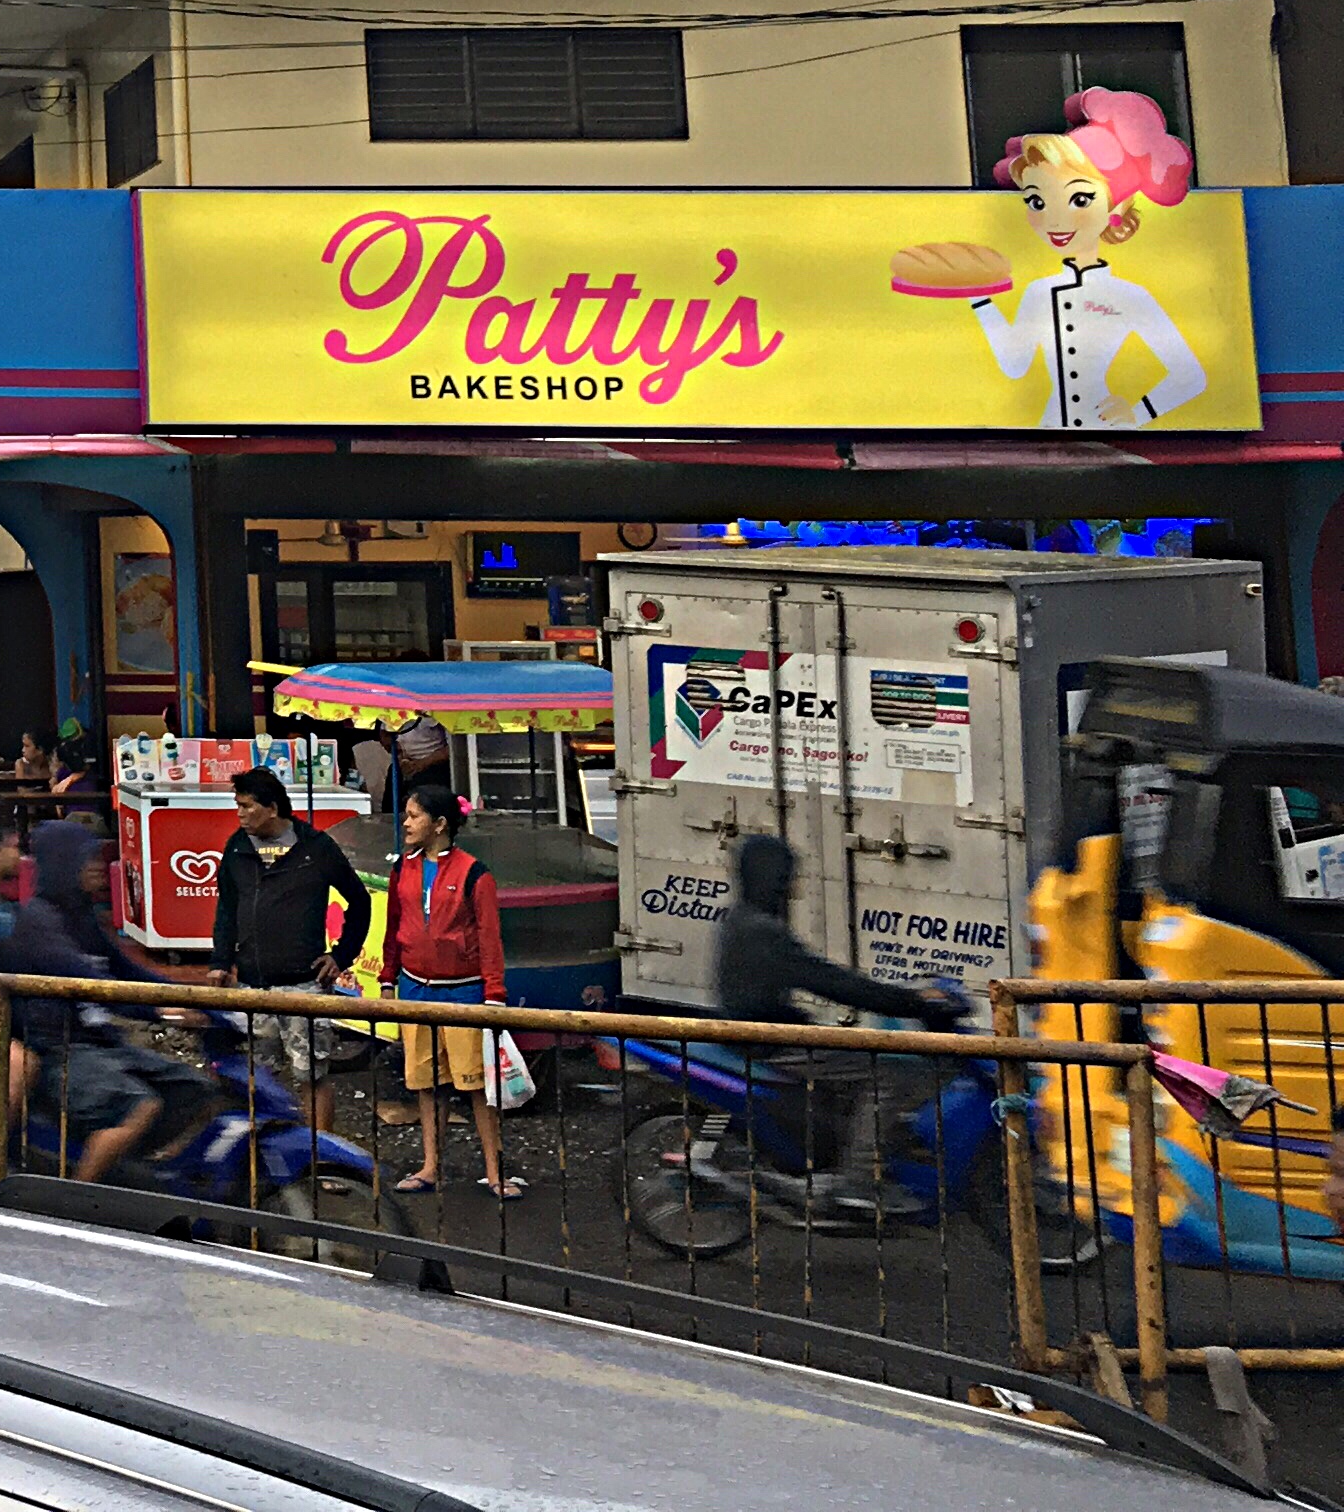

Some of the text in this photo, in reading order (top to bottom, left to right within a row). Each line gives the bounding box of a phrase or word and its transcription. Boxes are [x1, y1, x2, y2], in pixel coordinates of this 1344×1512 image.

[321, 209, 786, 405] Patty's
[409, 374, 624, 400] BAKESHOP
[723, 687, 838, 719] CaPEx
[729, 740, 769, 756] Cargo
[176, 887, 220, 897] SELECT
[664, 874, 730, 898] KEEP
[862, 909, 1007, 950] NOT FOR HIRE
[907, 945, 927, 957] MY
[930, 949, 994, 968] DRIVING?
[913, 961, 964, 976] HOTLINE
